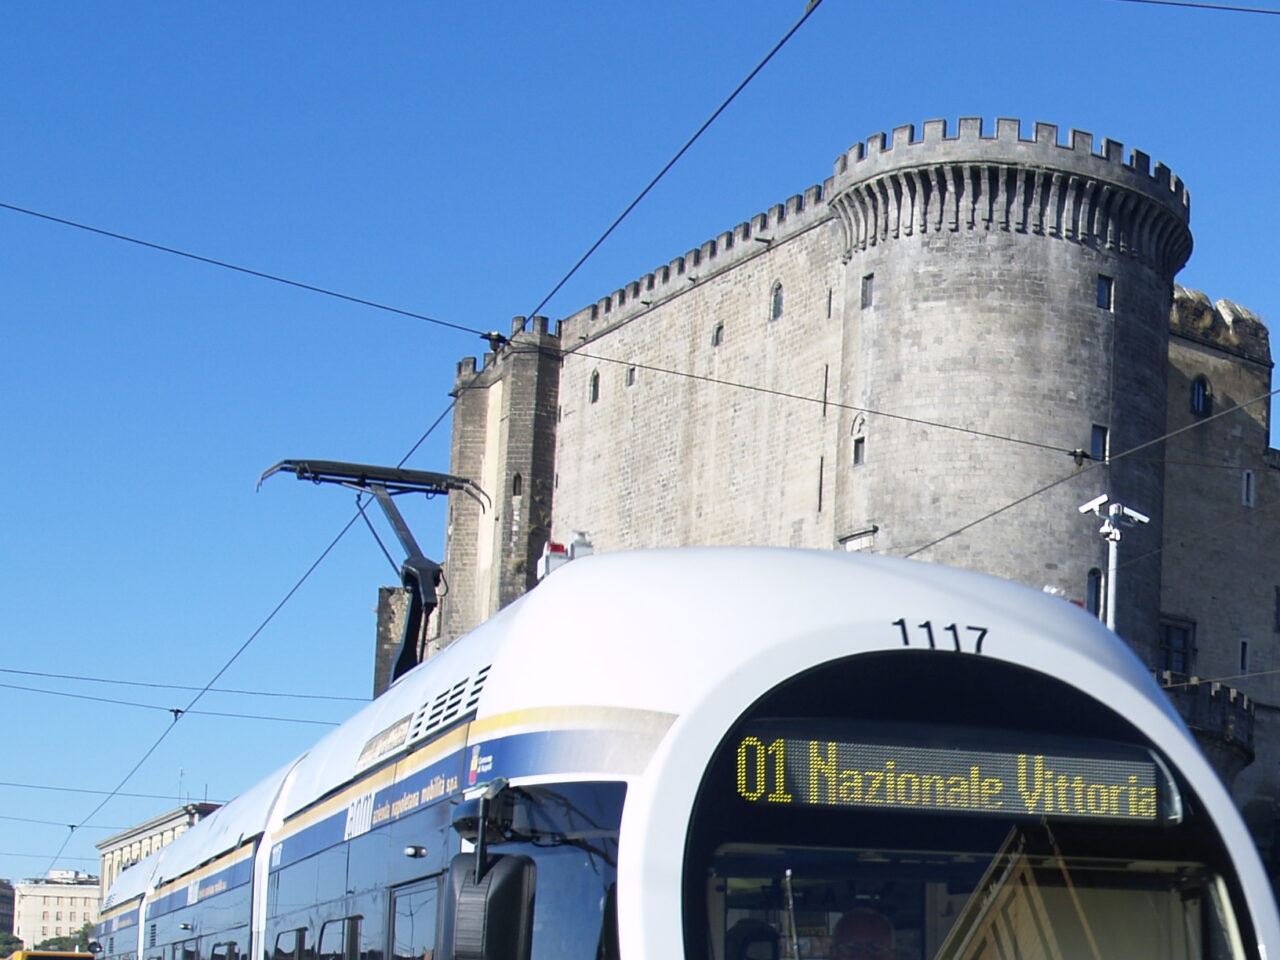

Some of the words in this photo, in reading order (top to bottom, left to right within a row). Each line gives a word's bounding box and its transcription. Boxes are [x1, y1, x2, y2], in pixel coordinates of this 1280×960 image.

[892, 617, 988, 654] 1117
[736, 736, 792, 803] 01
[809, 740, 1004, 809] Nazionale
[1017, 753, 1157, 816] Vittoria
